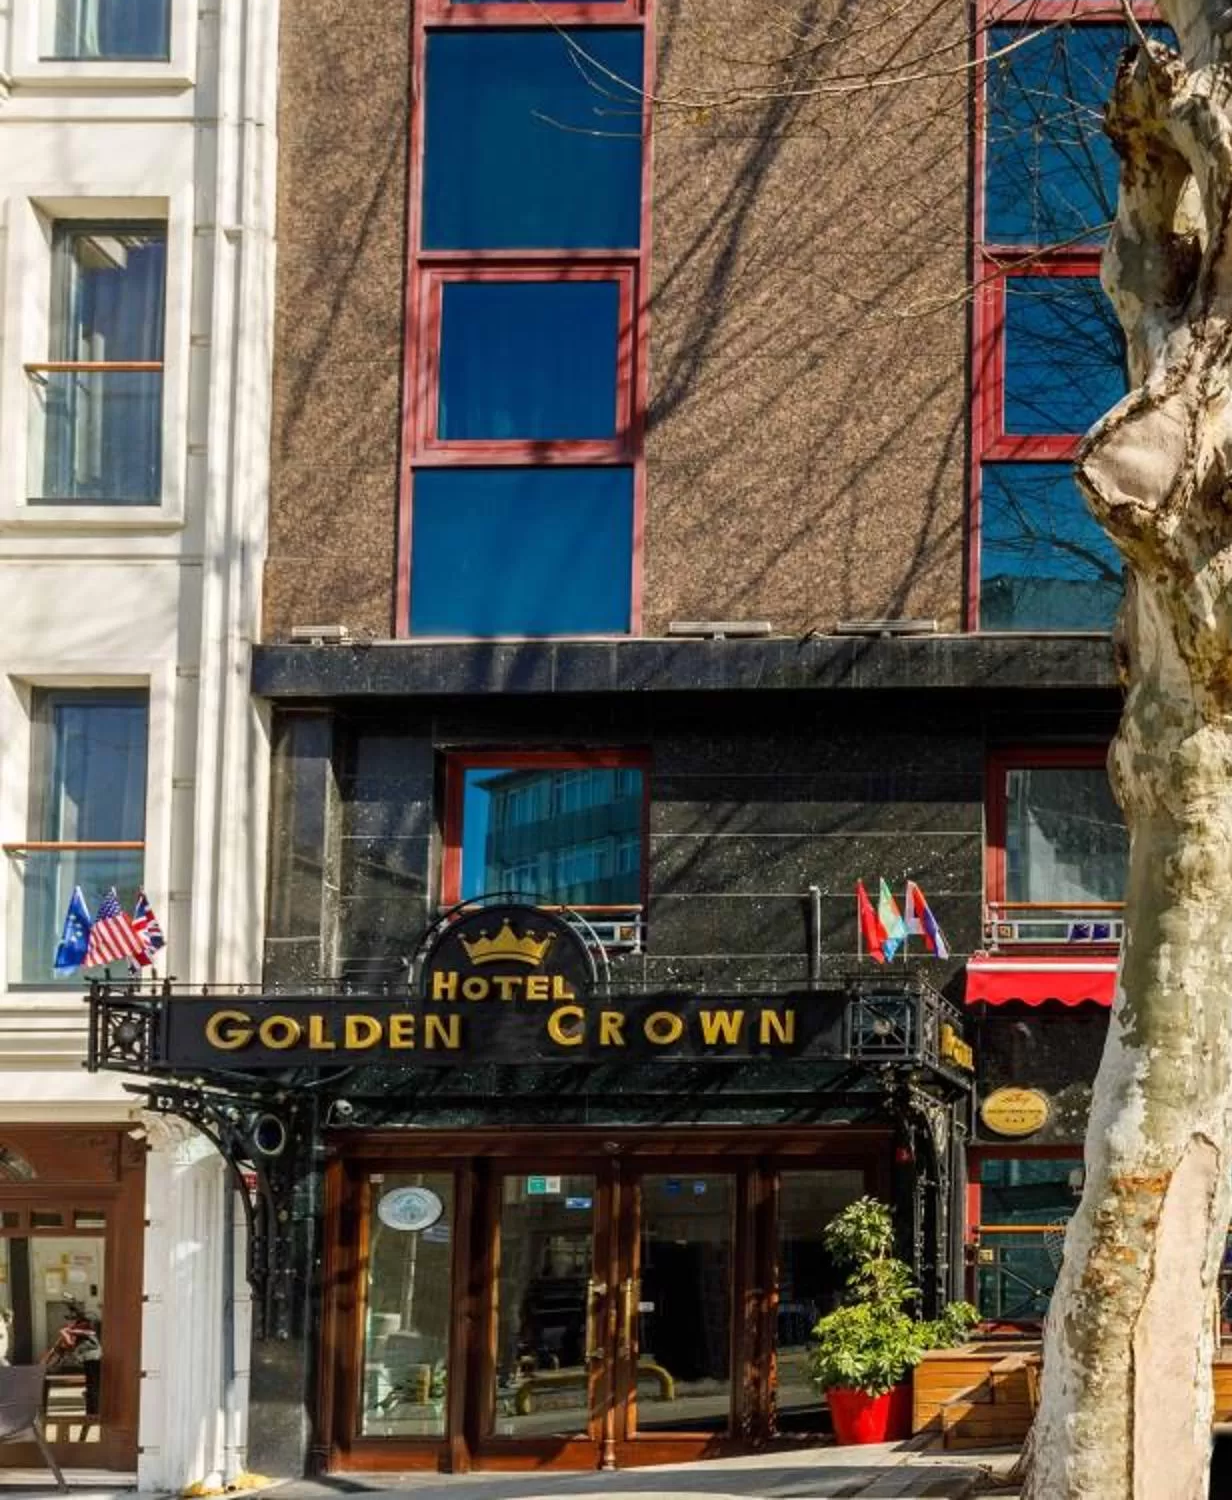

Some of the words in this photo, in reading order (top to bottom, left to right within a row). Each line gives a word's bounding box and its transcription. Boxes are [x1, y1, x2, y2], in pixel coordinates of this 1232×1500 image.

[432, 970, 575, 1001] HOTEL
[205, 1009, 461, 1049] GOLDEN
[546, 1005, 795, 1046] CROWN
